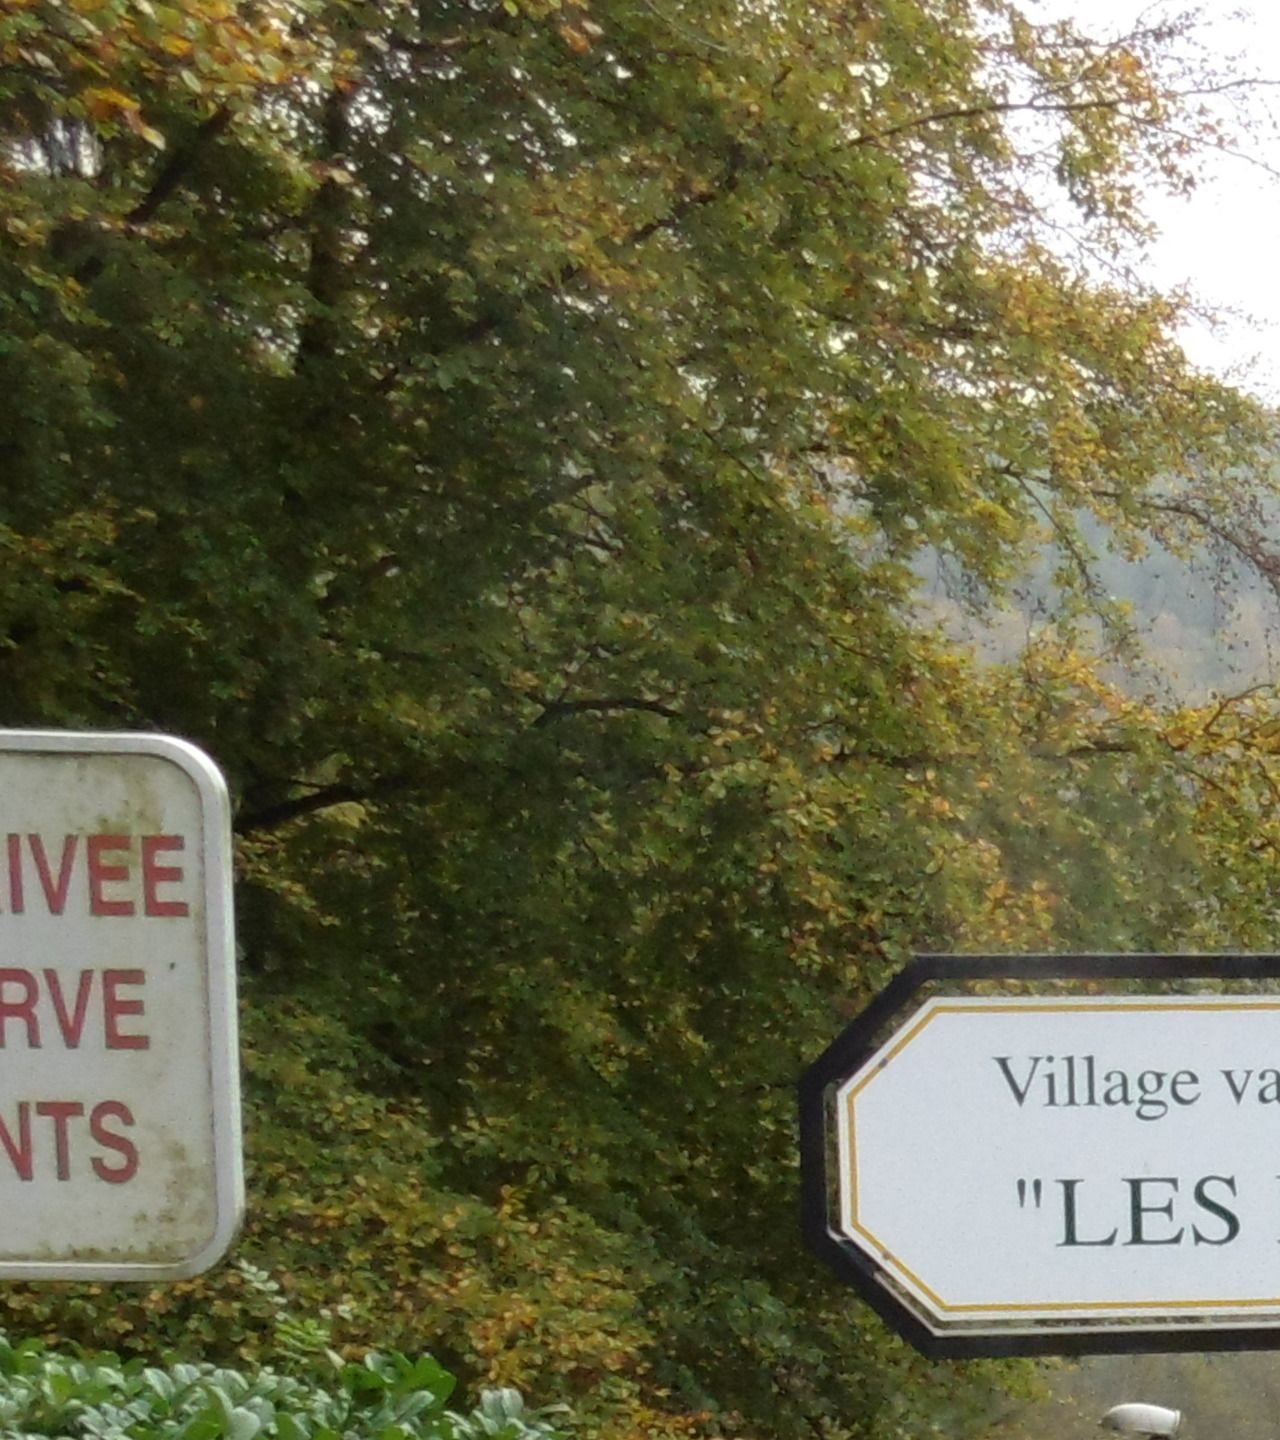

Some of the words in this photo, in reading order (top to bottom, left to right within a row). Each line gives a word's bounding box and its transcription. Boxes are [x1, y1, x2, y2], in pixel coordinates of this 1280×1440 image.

[0, 833, 190, 917] IVEE
[0, 967, 150, 1050] RVE
[992, 1050, 1200, 1122] Village
[1016, 1177, 1241, 1248] "LES
